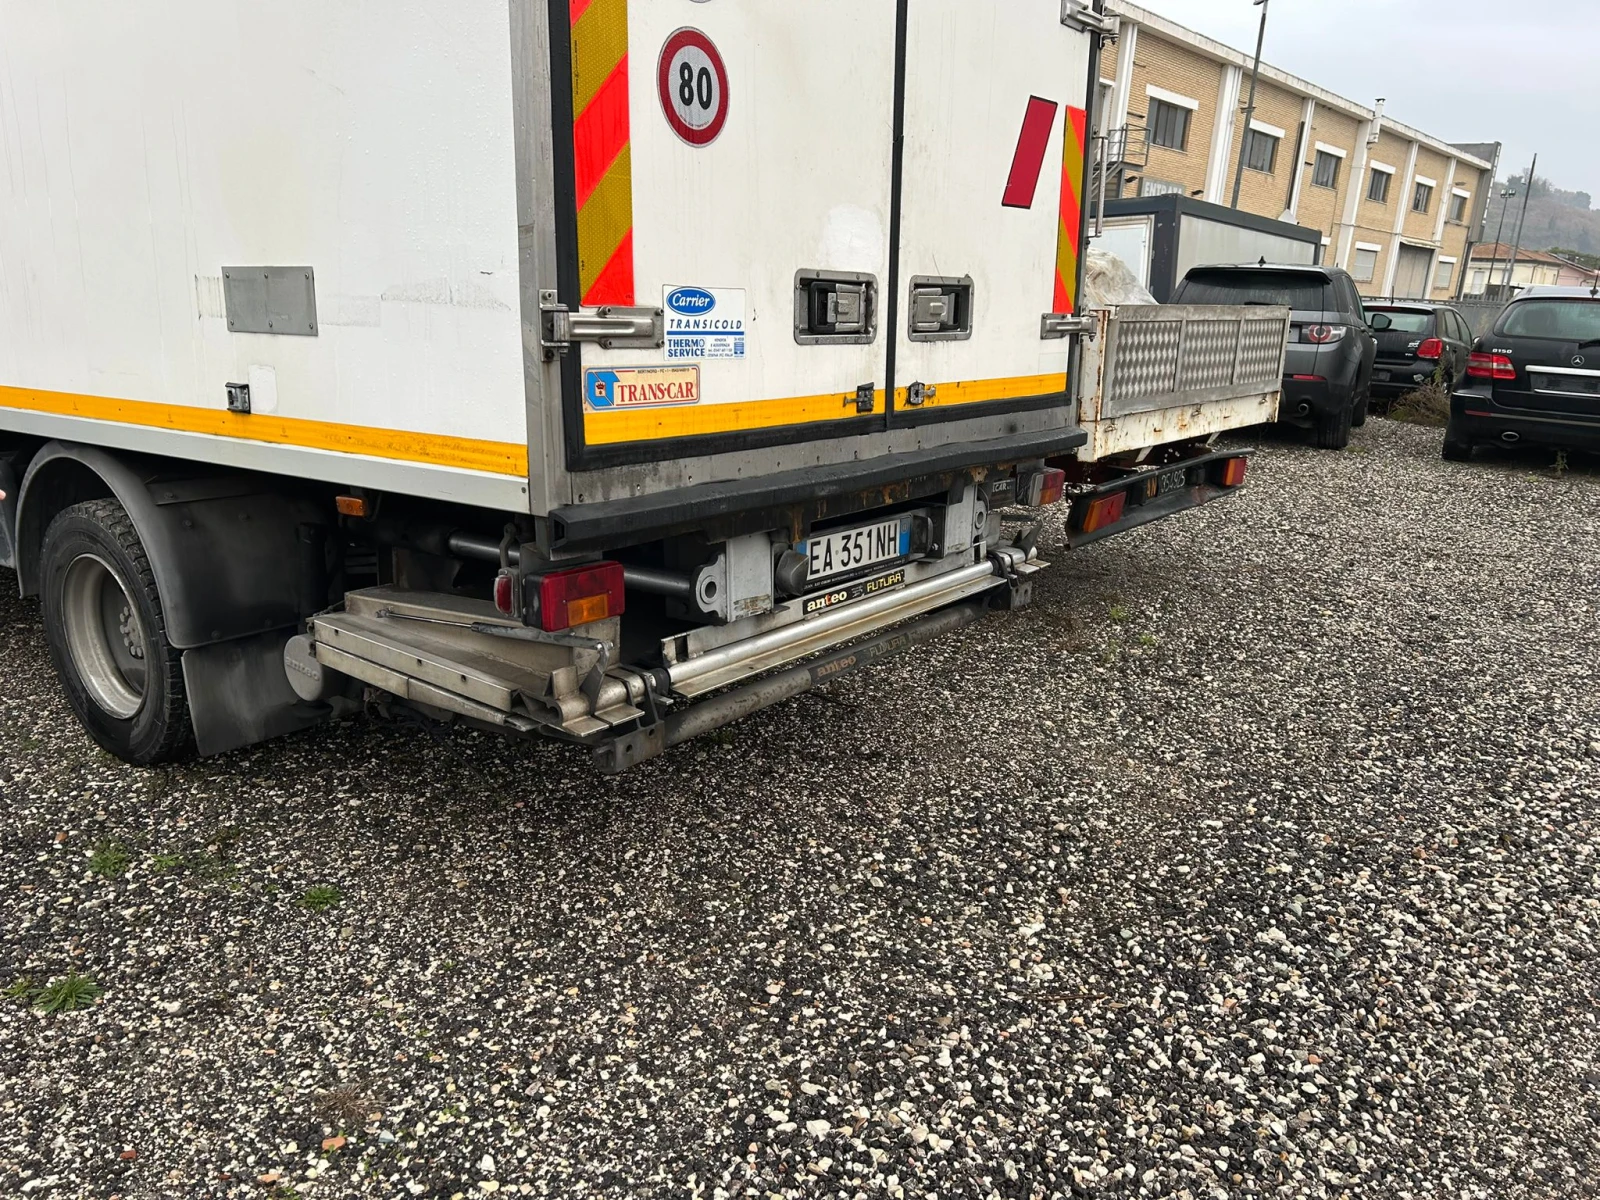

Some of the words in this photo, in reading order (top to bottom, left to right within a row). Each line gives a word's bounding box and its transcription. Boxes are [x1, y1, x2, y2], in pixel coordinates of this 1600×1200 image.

[679, 61, 713, 111] 80
[672, 293, 711, 308] Carrier
[670, 318, 742, 330] TRANSICOLD
[667, 338, 706, 348] THERMO
[667, 347, 706, 358] SERVICE
[840, 522, 899, 568] 351NH
[806, 590, 848, 612] anteo
[866, 573, 902, 592] FUTURA
[286, 656, 320, 681] anteo
[817, 656, 857, 678] anteo
